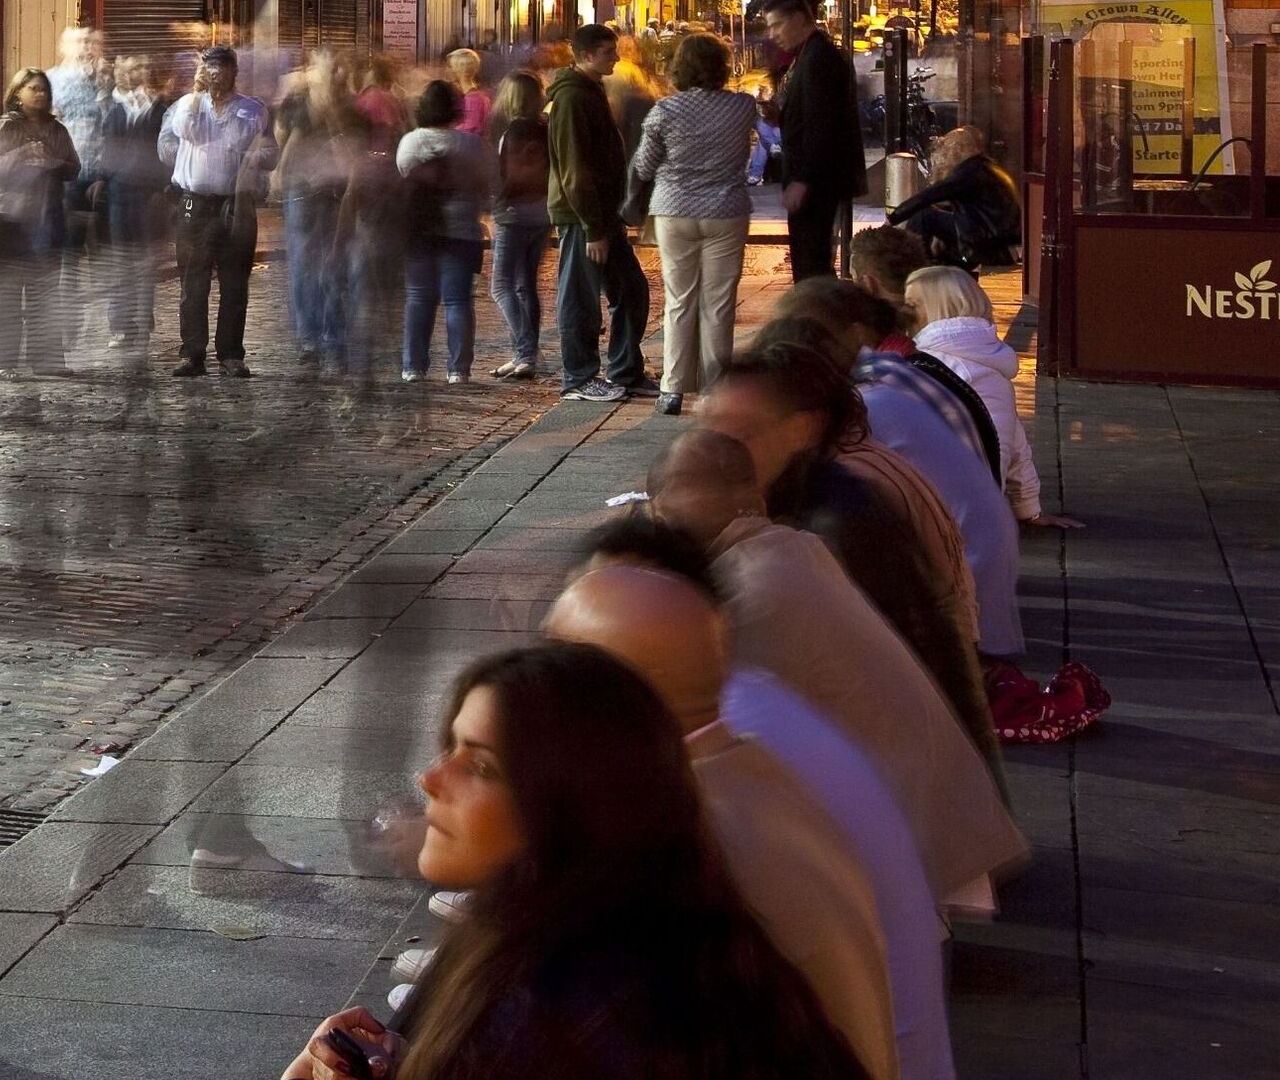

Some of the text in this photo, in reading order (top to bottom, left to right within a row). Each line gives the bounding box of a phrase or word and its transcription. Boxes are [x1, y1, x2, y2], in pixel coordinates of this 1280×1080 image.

[1085, 4, 1188, 24] Crown Alley
[1160, 72, 1183, 81] Her
[1133, 90, 1184, 98] tainmen
[1134, 122, 1150, 132] ed
[1154, 122, 1161, 131] 7
[1135, 150, 1182, 161] Starte
[1185, 284, 1280, 320] NEST
